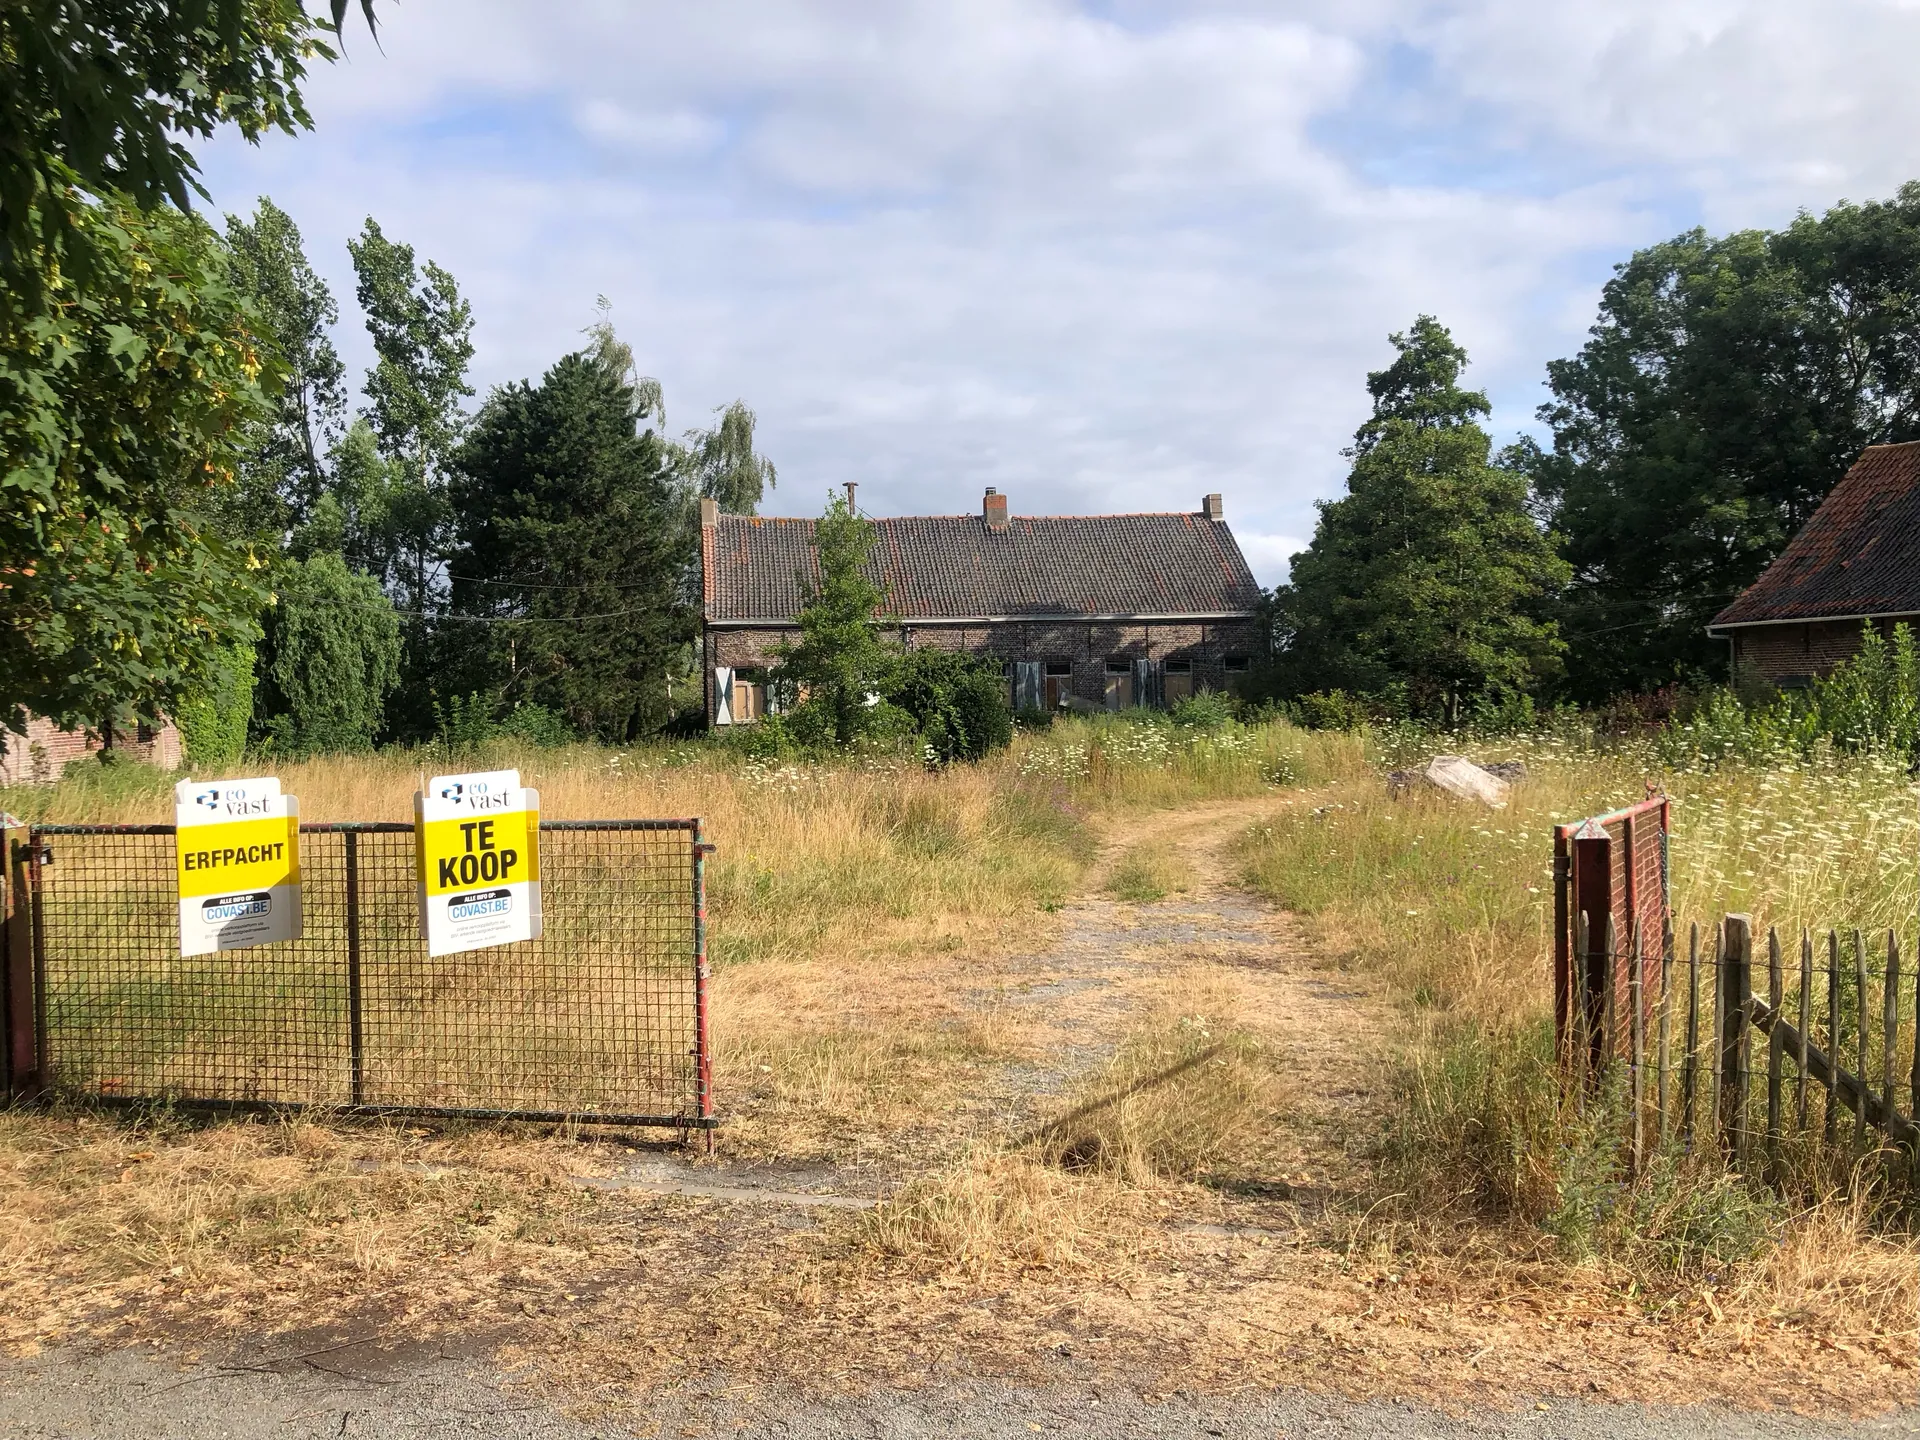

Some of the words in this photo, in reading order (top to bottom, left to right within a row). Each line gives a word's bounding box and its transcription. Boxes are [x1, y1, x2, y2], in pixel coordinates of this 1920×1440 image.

[225, 788, 246, 802] co
[469, 782, 488, 796] co
[469, 787, 511, 810] vast
[226, 794, 271, 816] vast
[459, 820, 496, 853] TE
[184, 842, 284, 871] ERFPACHT
[439, 848, 518, 889] KOOP
[232, 895, 245, 903] INFO
[245, 894, 255, 902] OP:
[452, 898, 508, 919] COVAST.BE
[206, 901, 268, 920] COVAST.BE
